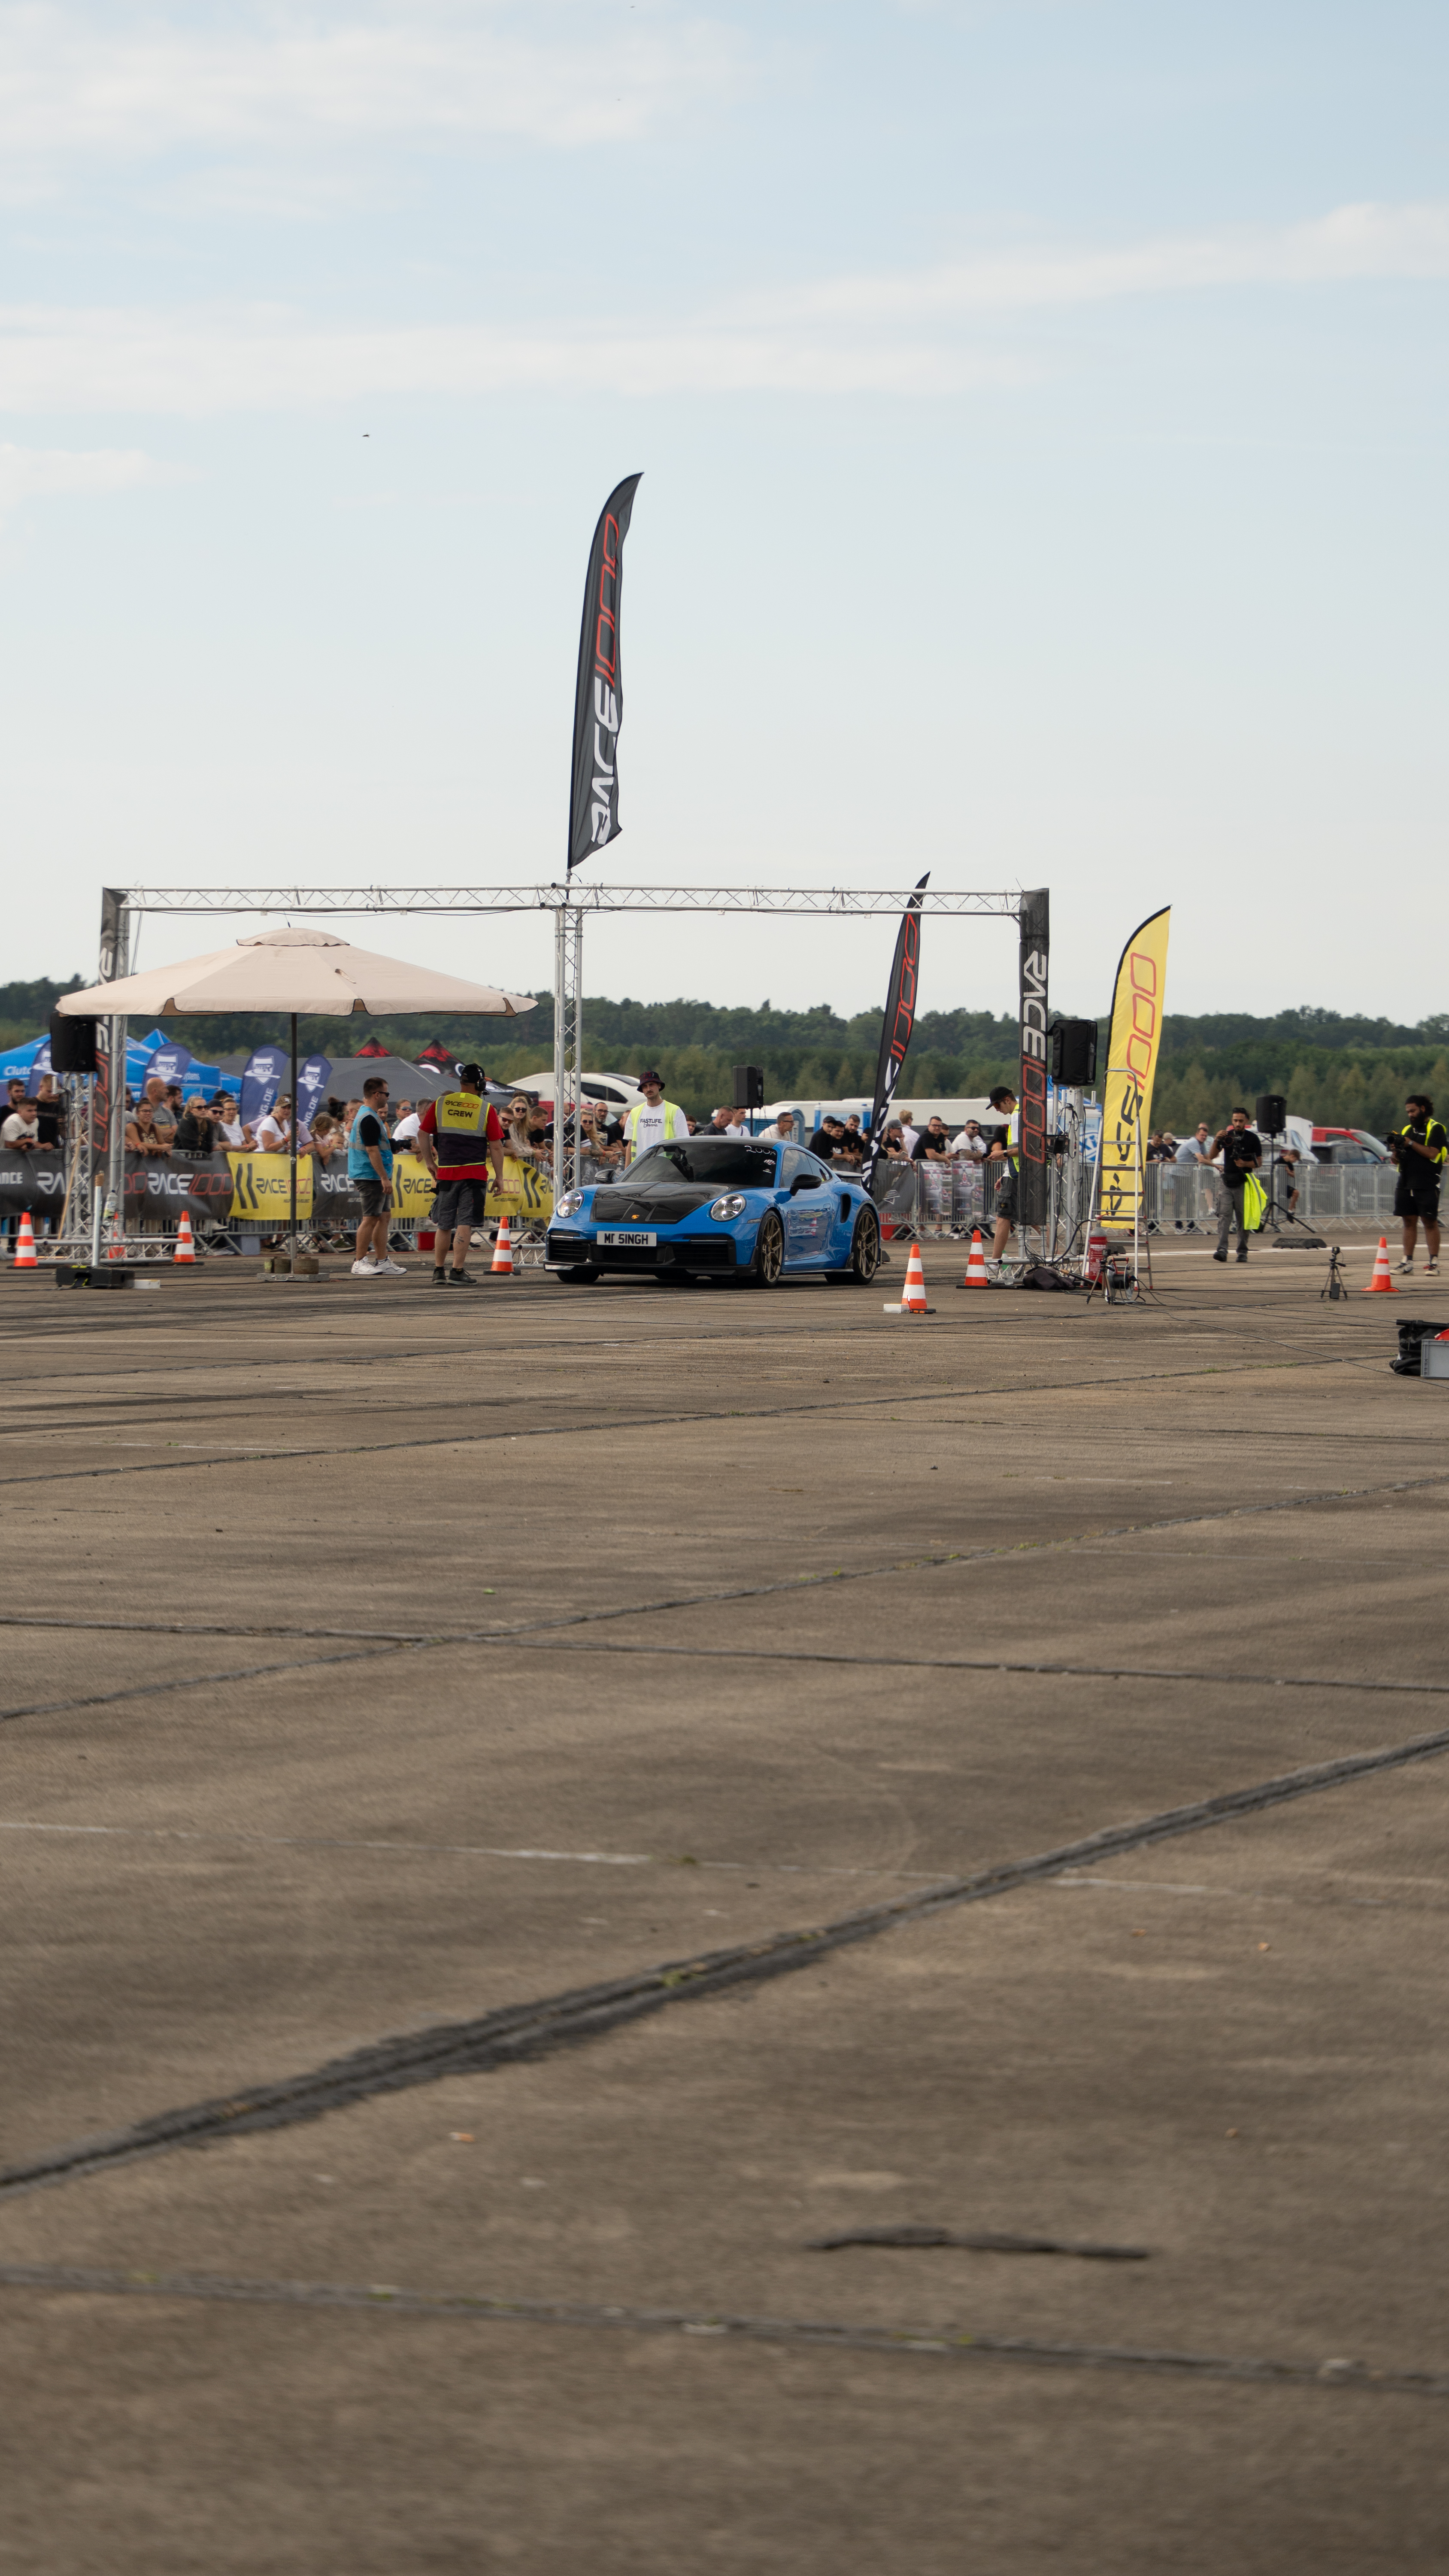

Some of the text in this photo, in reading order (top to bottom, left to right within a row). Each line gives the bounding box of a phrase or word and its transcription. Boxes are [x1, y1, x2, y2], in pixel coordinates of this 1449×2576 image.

[93, 947, 113, 1152] RE1000
[1022, 950, 1047, 1164] RACE1000
[445, 1100, 479, 1109] RACE1000
[448, 1109, 473, 1118] CREW
[147, 1172, 234, 1195] RACE1000
